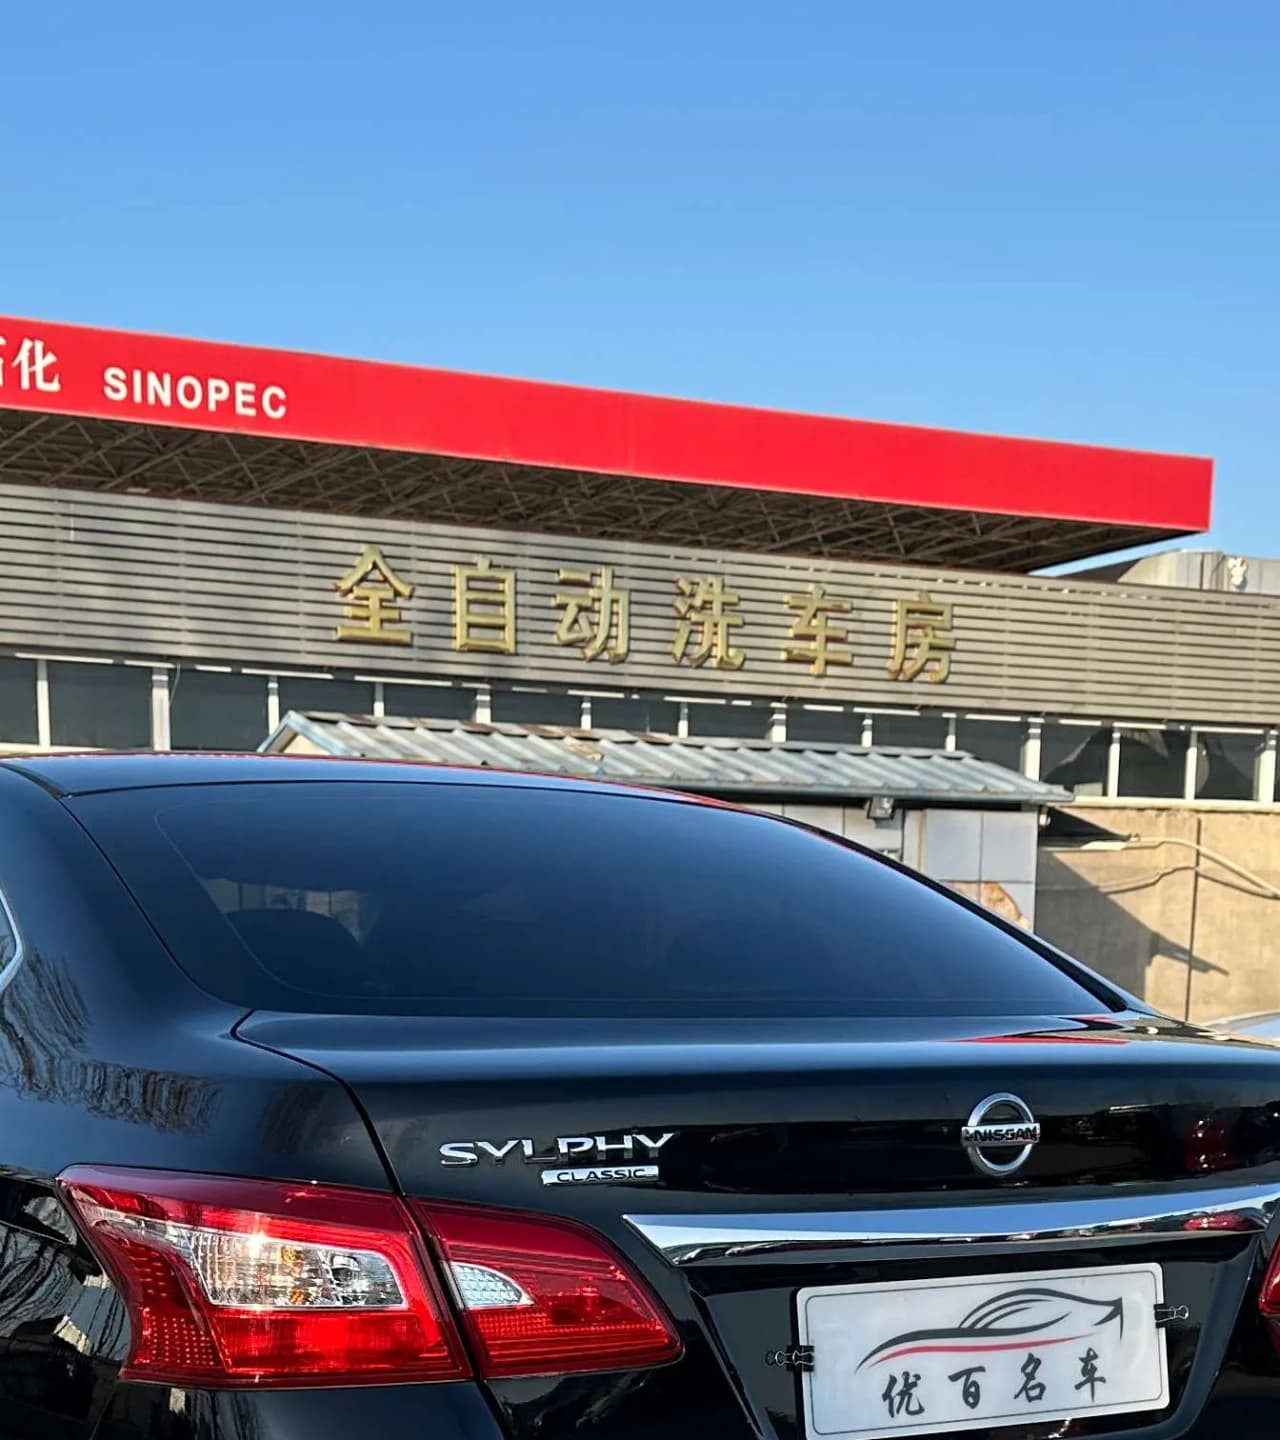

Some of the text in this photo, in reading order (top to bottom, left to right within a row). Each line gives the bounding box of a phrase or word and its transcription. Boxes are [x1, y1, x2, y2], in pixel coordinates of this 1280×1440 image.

[103, 366, 288, 420] SINOPEC
[334, 544, 957, 684] 全自动洗车房
[438, 1131, 676, 1166] SYLPHY
[973, 1126, 1038, 1142] NISSAN
[556, 1168, 646, 1183] CLASSIC
[881, 1346, 1107, 1419] 优百名车
